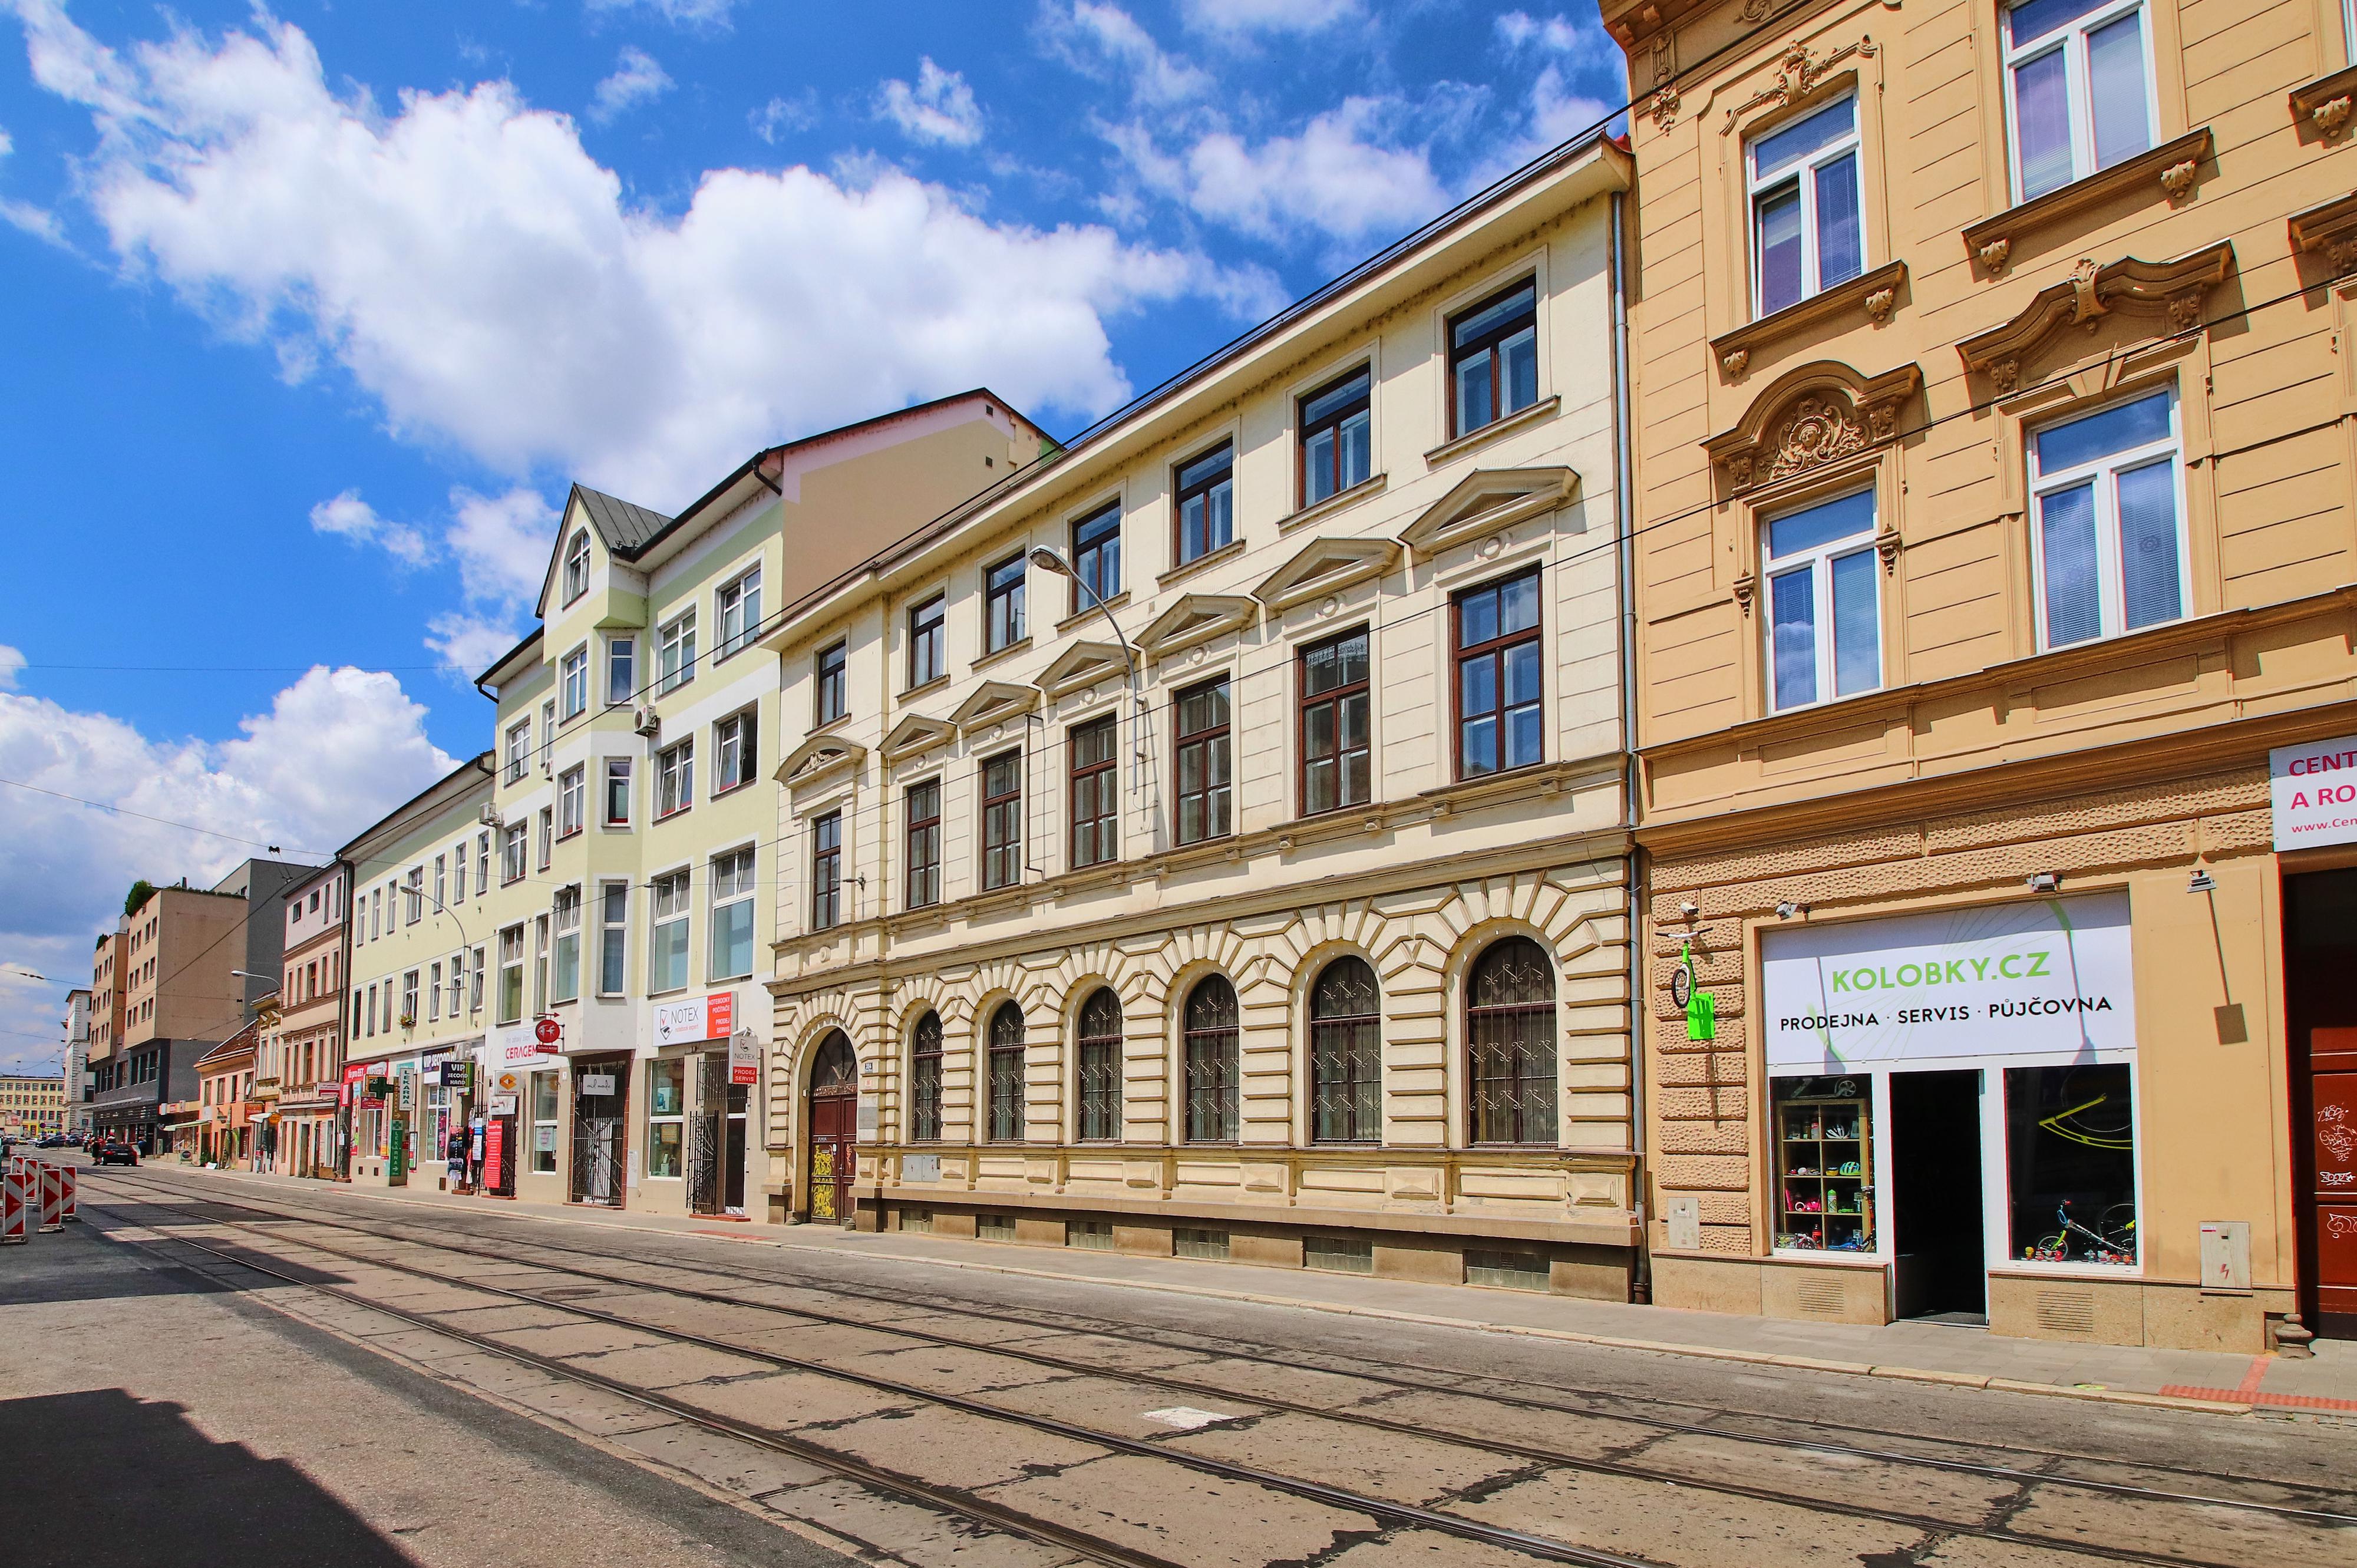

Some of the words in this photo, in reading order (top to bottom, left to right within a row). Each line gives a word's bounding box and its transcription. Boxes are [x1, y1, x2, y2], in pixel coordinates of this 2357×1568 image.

[2289, 750, 2357, 777] CENT
[2290, 792, 2309, 810] A
[2318, 784, 2356, 806] RO
[1832, 951, 2051, 993] KOLOBKY.CZ
[708, 996, 731, 1006] NOTEBOOKY
[712, 1004, 730, 1014] POČÍTAČE
[671, 1006, 699, 1024] NOTEX
[1780, 1012, 1880, 1031] PRODEJNA
[1897, 1005, 1970, 1024] SERVIS
[1989, 996, 2112, 1018] PŮJČOVNA
[506, 1044, 537, 1059] CERAGEM
[423, 1055, 431, 1068] VIP
